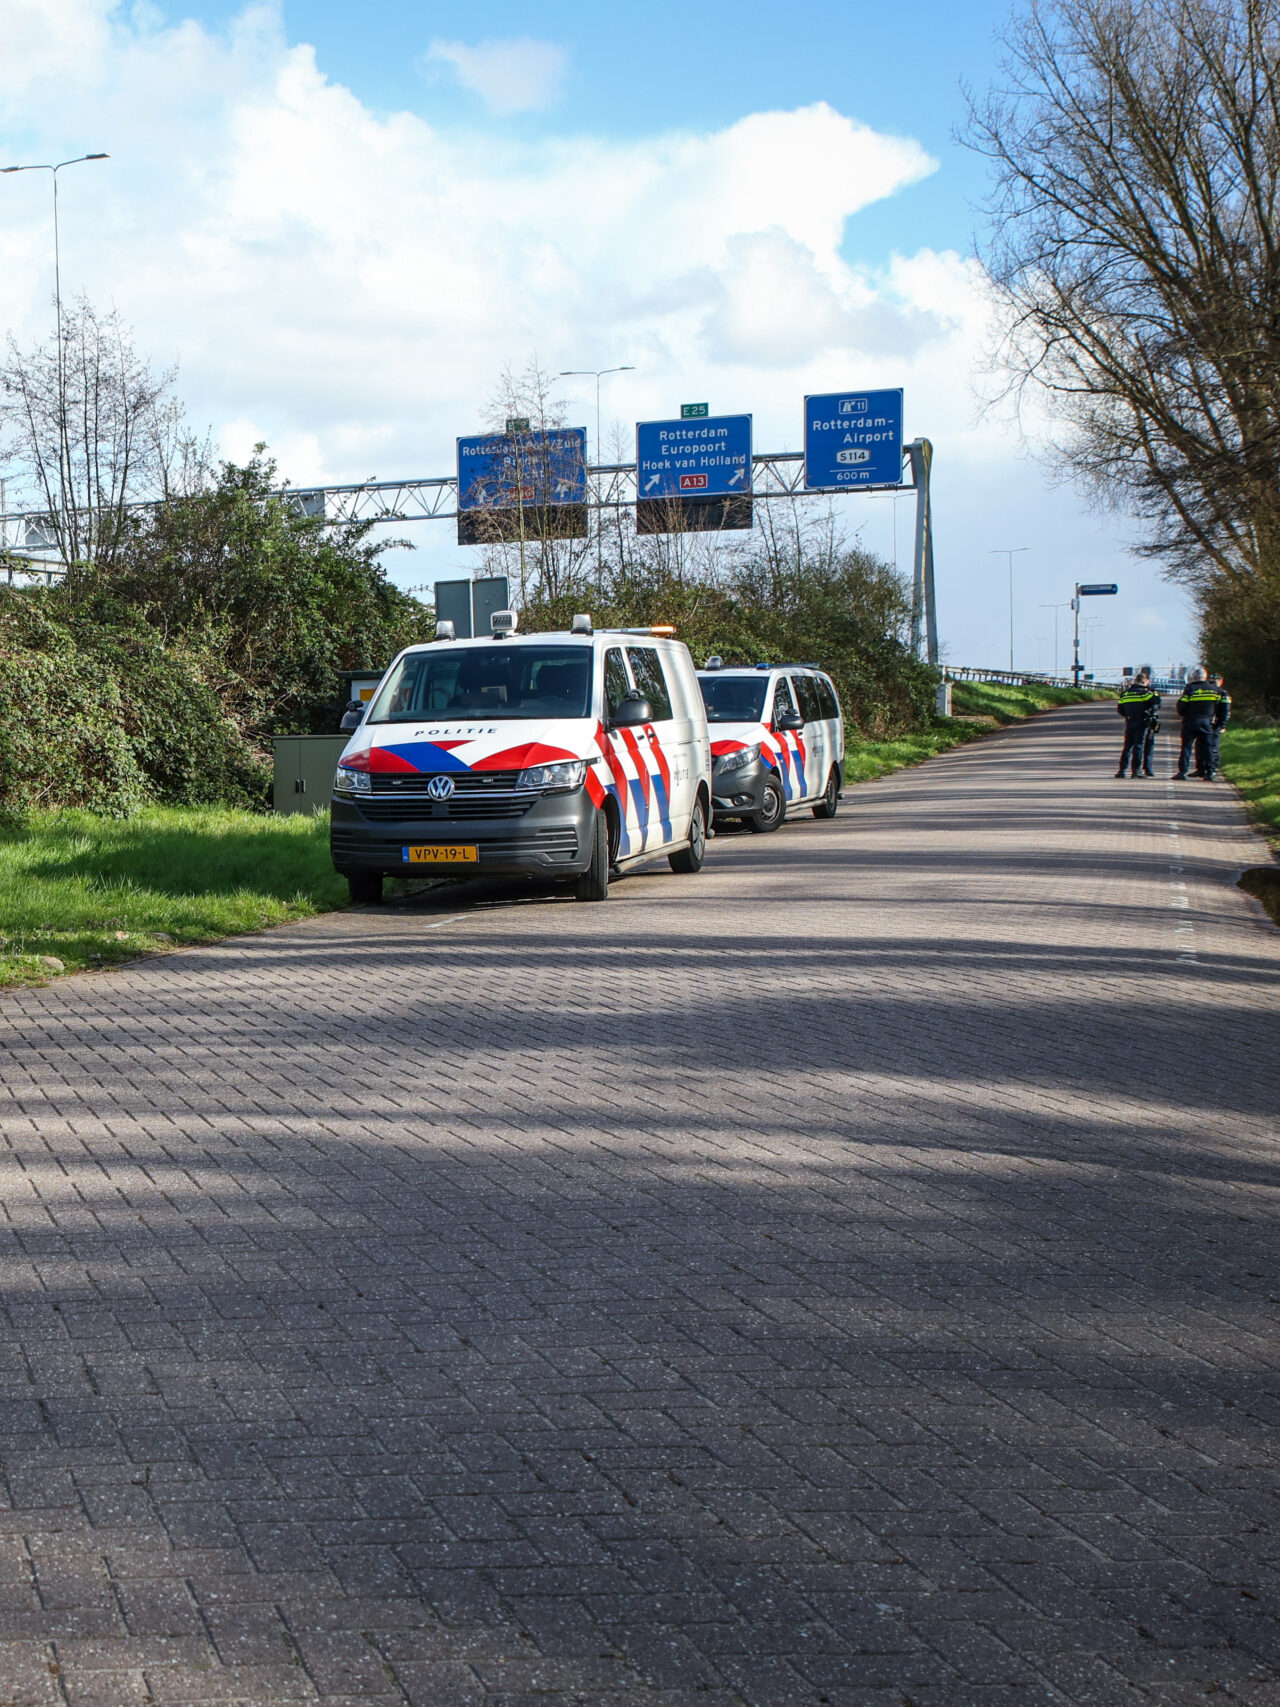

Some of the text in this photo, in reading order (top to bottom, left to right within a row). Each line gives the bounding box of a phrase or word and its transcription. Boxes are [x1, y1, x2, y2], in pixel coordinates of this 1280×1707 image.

[683, 405, 706, 416] E25
[857, 401, 865, 410] 11
[813, 417, 894, 431] Rotterdam-
[660, 428, 728, 441] Rotterdam
[843, 431, 894, 444] Airport
[661, 441, 726, 455] Europoort
[840, 451, 865, 461] S114
[642, 453, 746, 471] Hoek van Holland
[837, 471, 870, 480] 600 m
[683, 477, 705, 487] A13
[414, 728, 498, 737] POLITIE
[415, 848, 470, 860] VPV-19-L
